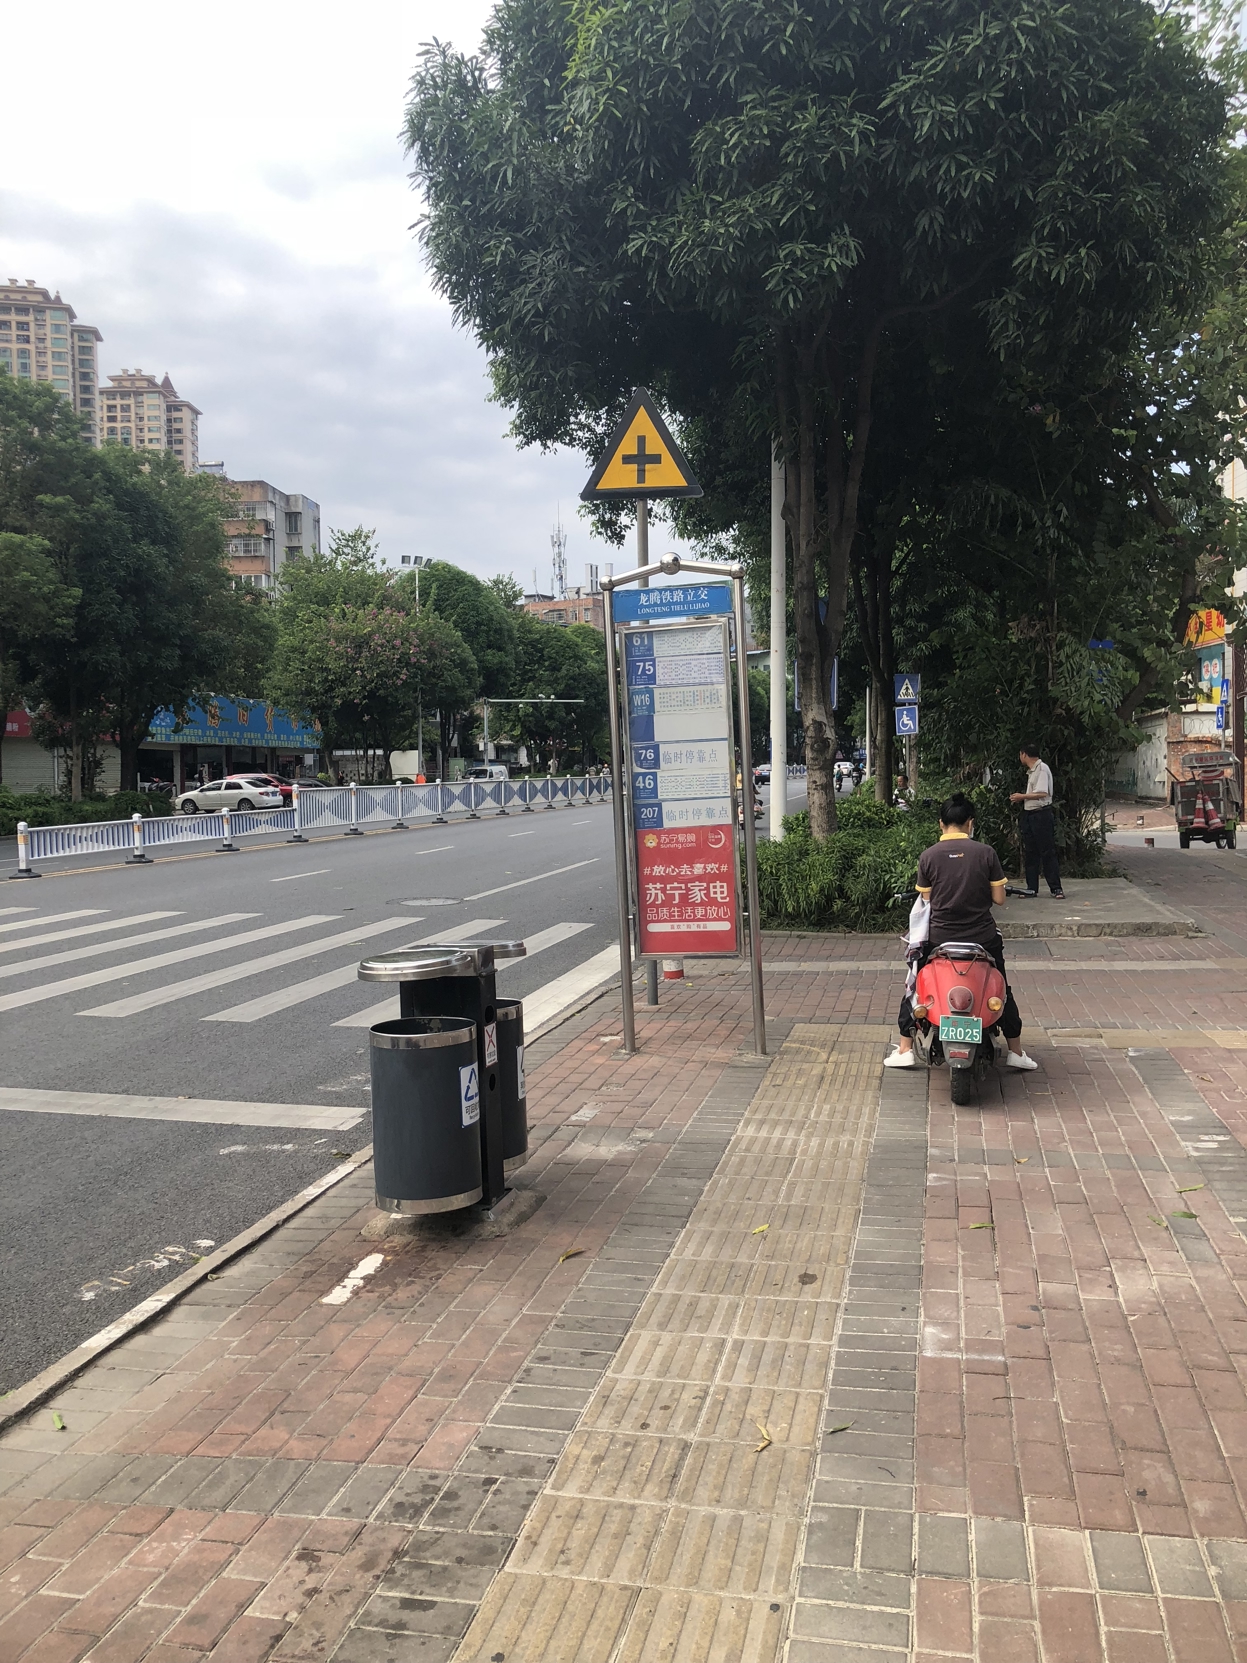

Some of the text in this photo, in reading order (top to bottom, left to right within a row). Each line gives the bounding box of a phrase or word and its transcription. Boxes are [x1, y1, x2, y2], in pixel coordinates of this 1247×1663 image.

[638, 587, 709, 606] 龙腾铁路立交
[637, 605, 670, 614] LONGTENG
[689, 602, 710, 610] LIJIAO
[632, 632, 648, 646] 61
[635, 661, 654, 675] 75
[632, 693, 651, 707] W16
[638, 749, 655, 760] 76
[662, 748, 718, 765] 临时停靠点
[635, 775, 654, 789] 46
[640, 807, 659, 819] 207
[665, 805, 729, 822] 临时停靠点
[660, 833, 696, 844] 苏宁易购
[643, 862, 729, 876] #放心去喜欢#
[644, 881, 730, 905] 苏宁家电
[646, 905, 731, 921] 品质生活更放心
[942, 1026, 980, 1041] ZR025
